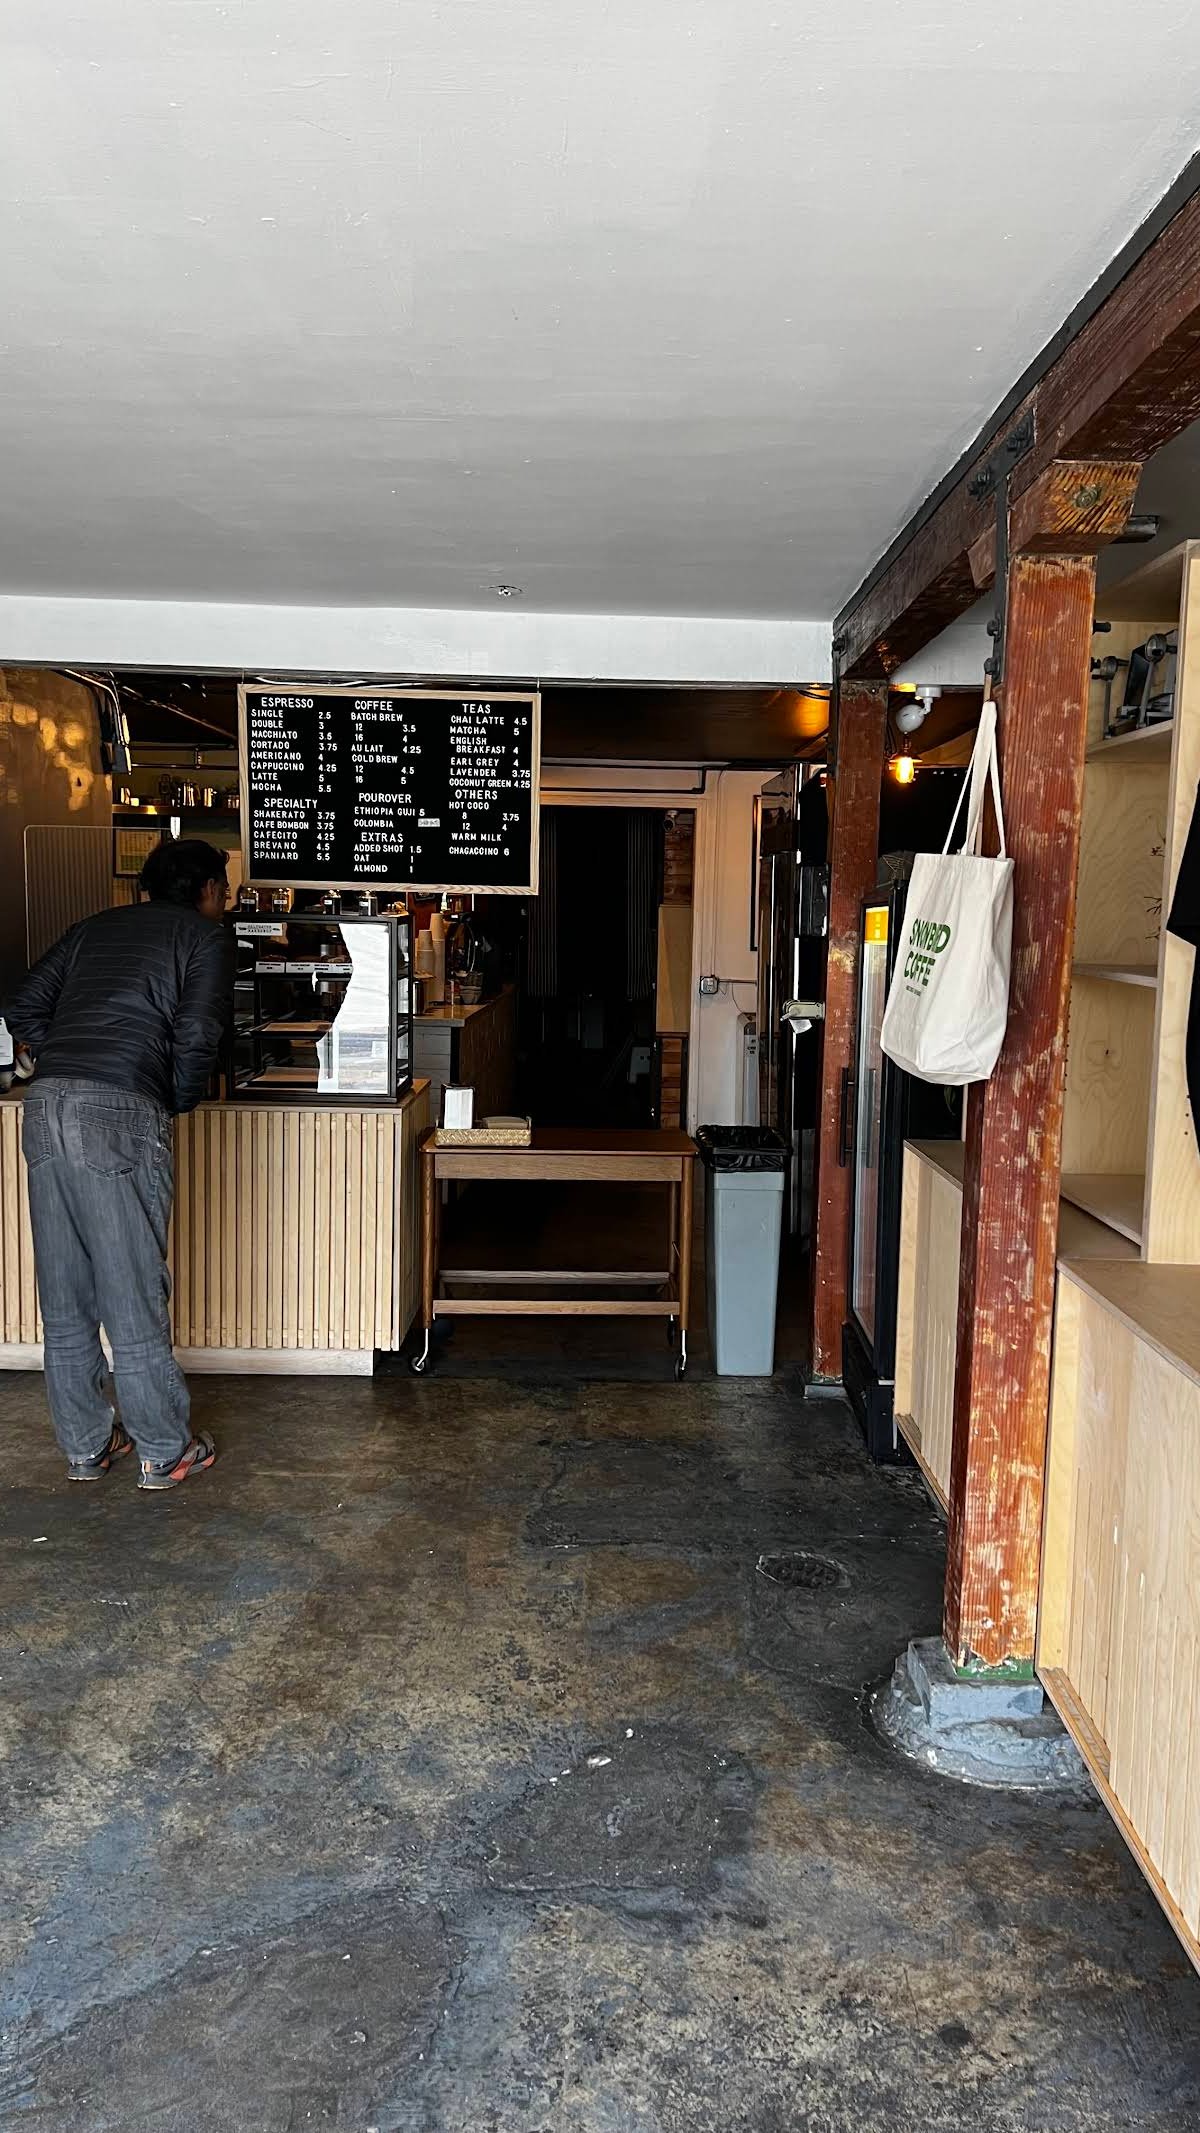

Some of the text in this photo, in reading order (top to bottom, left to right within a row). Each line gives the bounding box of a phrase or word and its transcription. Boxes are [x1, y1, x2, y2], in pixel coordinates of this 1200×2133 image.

[261, 697, 313, 708] ESPRESSO
[355, 701, 393, 711] COFFEE
[462, 704, 491, 713] TEAS
[251, 709, 283, 718] SINGLE
[351, 712, 377, 721] BATCH
[252, 720, 283, 728] DOUBLE
[451, 715, 471, 724] CHAI
[476, 716, 504, 725] LATTE
[356, 723, 363, 731] 12
[450, 726, 519, 736] MATCHA 5
[252, 730, 332, 740] MACCHIATO 3.5
[450, 737, 487, 745] ENGLISH
[251, 741, 337, 751] CORTADO 3.75
[403, 746, 421, 754] 4.25
[456, 745, 506, 754] BREAKFAST
[251, 751, 301, 760] AMERICANO
[376, 755, 398, 763] BREW
[451, 757, 518, 767] EARL GREY 4
[251, 762, 337, 772] CAPPUCCINO 4.25
[356, 765, 414, 775] 12 4.5
[252, 772, 324, 782] LATTE 5
[450, 768, 496, 777] LAVENDER
[356, 775, 363, 783] 16
[449, 779, 530, 788] COCONUT GREEN 4.25
[252, 783, 281, 791] MOCHA
[359, 793, 412, 803] POUROVER
[455, 790, 497, 799] OTHERS
[264, 798, 317, 809] SPECIALTY
[467, 802, 489, 810] COCO
[254, 810, 305, 819] SHAKERATO
[355, 806, 393, 816] ETHIOPIA
[397, 808, 416, 816] GUJI
[462, 812, 519, 821] 8 3.75
[254, 820, 334, 830] CAFE BOMBON 3.75
[354, 819, 393, 828] COLOMBIA
[254, 831, 297, 840] CAFECITO
[362, 832, 403, 843] EXTRAS
[452, 833, 501, 842] WARM MILK
[254, 841, 330, 851] BREVANO 4.5
[354, 844, 380, 852] ADDED
[383, 845, 403, 853] SHOT
[449, 847, 509, 856] CHAGACCINO 6
[254, 852, 330, 861] SPANIARD 5.5
[354, 854, 370, 862] OAT
[354, 865, 388, 873] ALMOND
